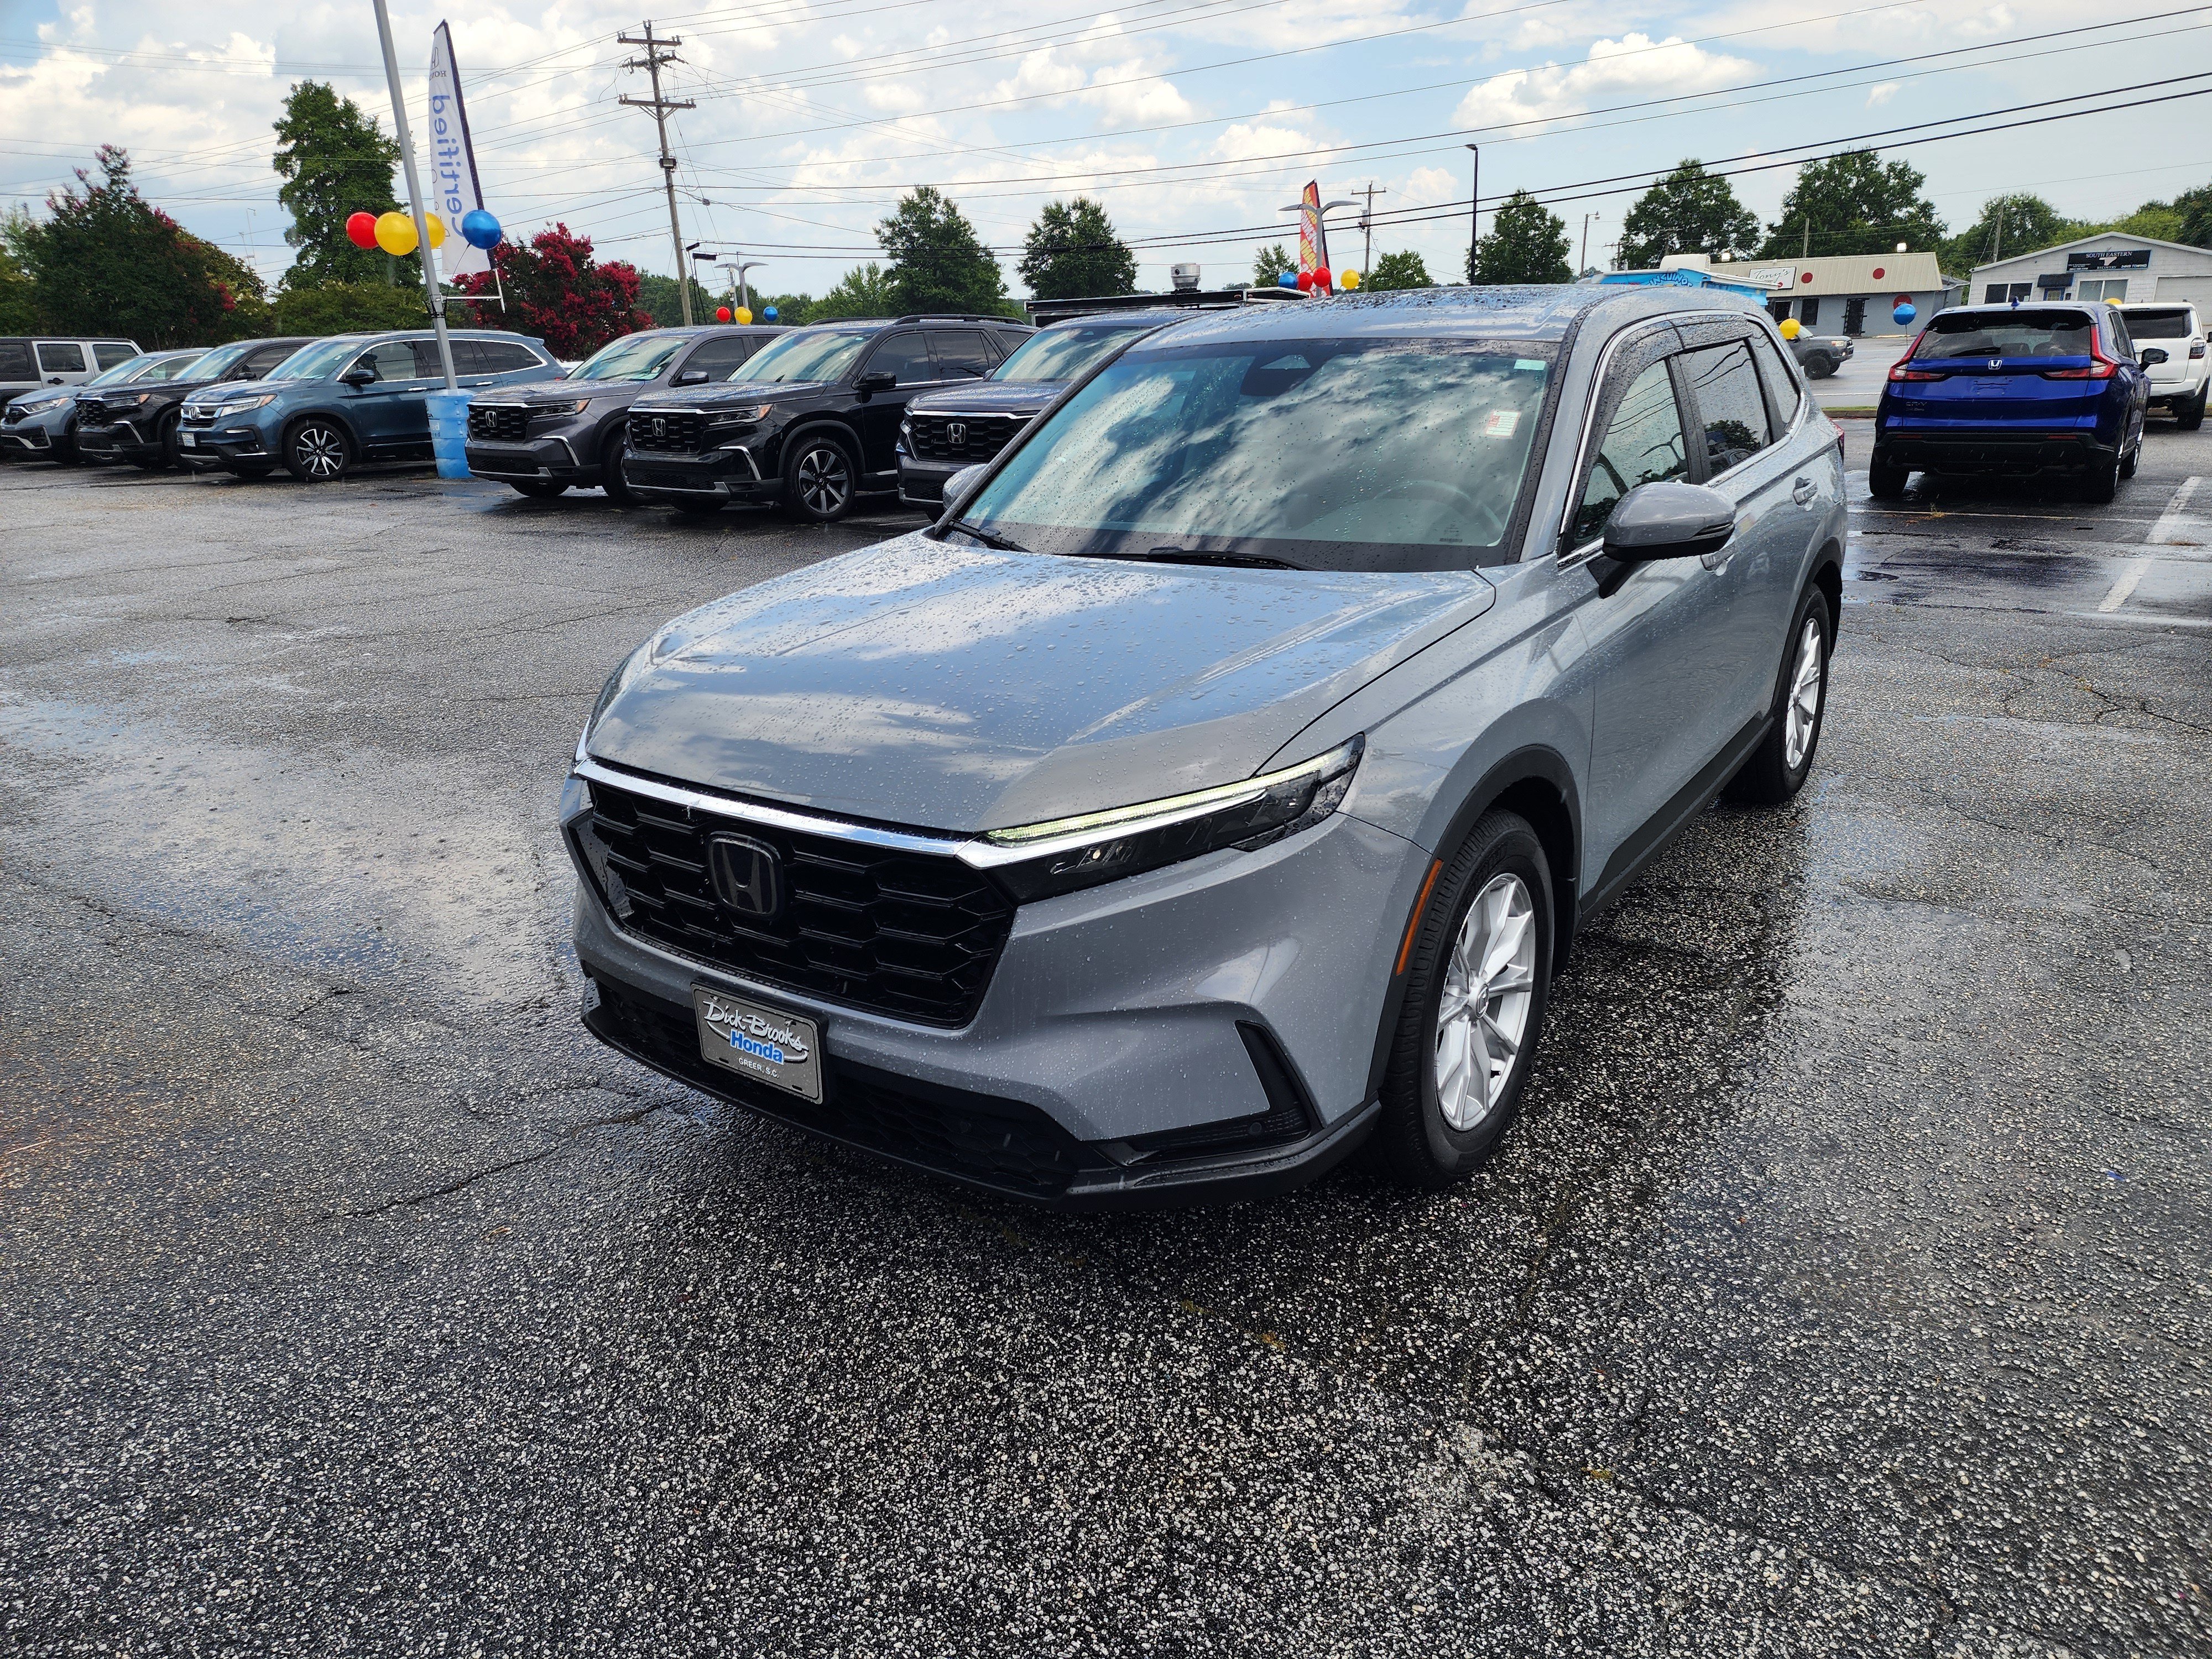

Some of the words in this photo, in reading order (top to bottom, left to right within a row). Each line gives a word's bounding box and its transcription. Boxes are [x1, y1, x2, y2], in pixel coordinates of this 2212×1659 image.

[1754, 269, 1790, 283] Tony's
[730, 1029, 784, 1066] Honda
[738, 1057, 764, 1074] GREER,
[765, 1067, 779, 1078] S.C.
